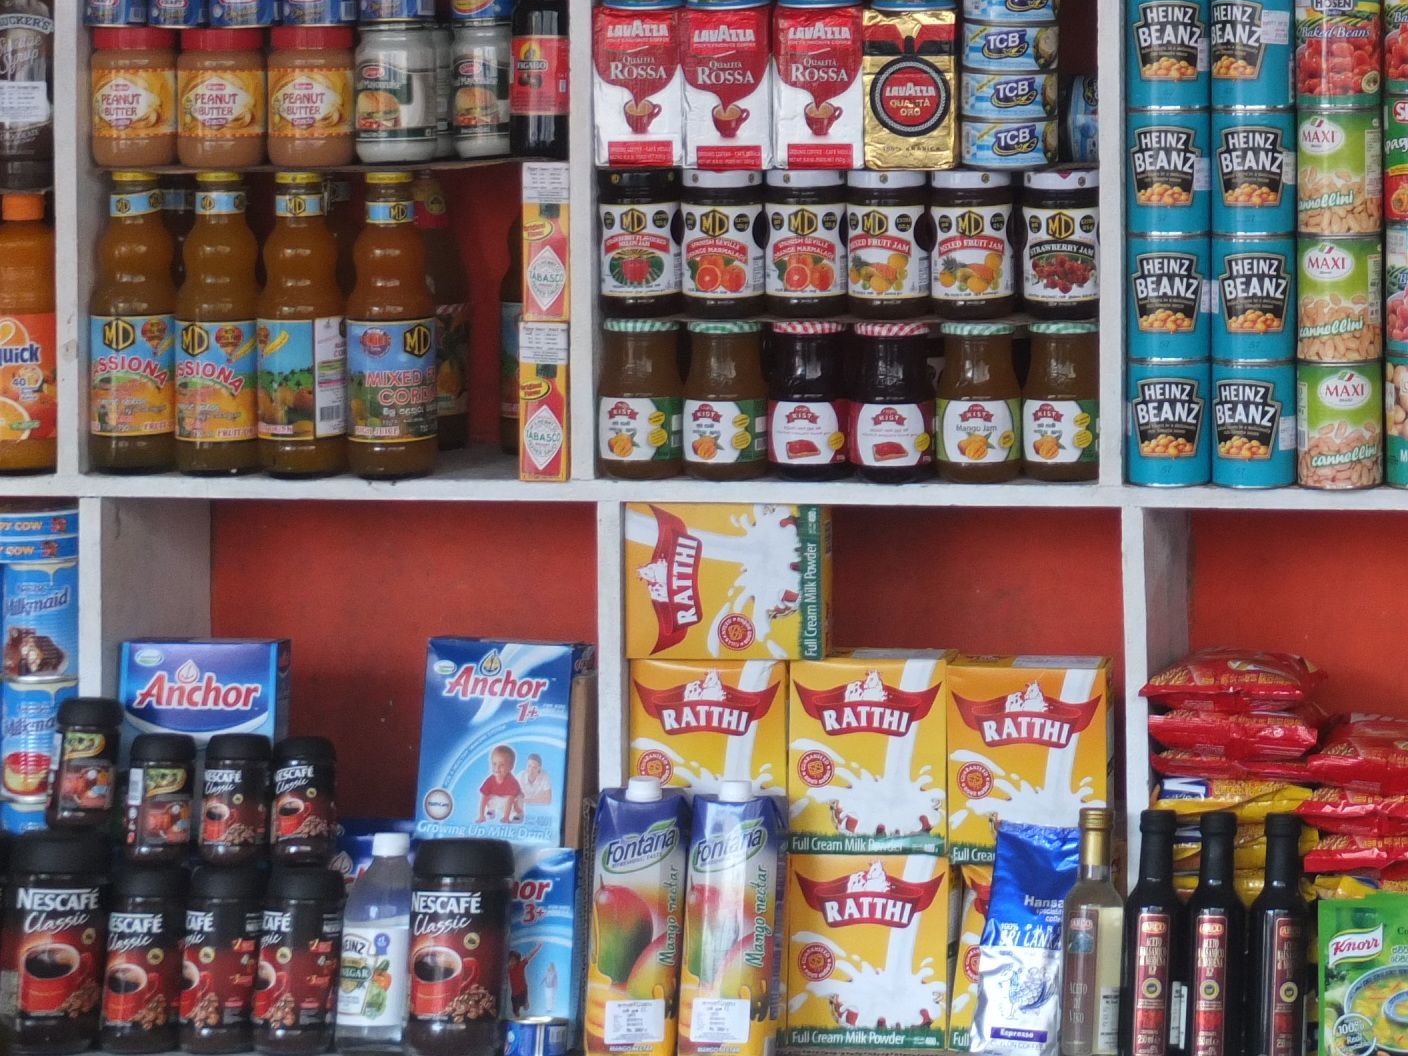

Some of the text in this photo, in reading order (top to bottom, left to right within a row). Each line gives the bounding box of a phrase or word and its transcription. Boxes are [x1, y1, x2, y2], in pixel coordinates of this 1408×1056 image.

[1146, 4, 1193, 24] HEINZ
[694, 26, 754, 41] LAVAZZA
[1139, 24, 1202, 46] BEANZ
[696, 67, 755, 84] ROSSA
[194, 93, 237, 105] PEANUT
[198, 105, 234, 117] BUTTER
[1228, 132, 1274, 150] HEINZ
[1220, 150, 1283, 172] BEANZ
[622, 211, 647, 234] MD
[529, 271, 564, 283] TABASCO
[1324, 381, 1365, 398] MAXI
[956, 424, 997, 435] Mango Jam
[677, 535, 697, 626] RATTHI
[135, 673, 260, 709] Anchor
[444, 664, 548, 699] Anchor
[663, 705, 749, 731] RATTHI
[17, 889, 100, 911] NESCAFÉ
[825, 896, 912, 923] RATTHI
[24, 910, 90, 933] Classic
[1331, 933, 1381, 955] Knorr
[792, 1030, 906, 1045] Full Cream Milk Powder
